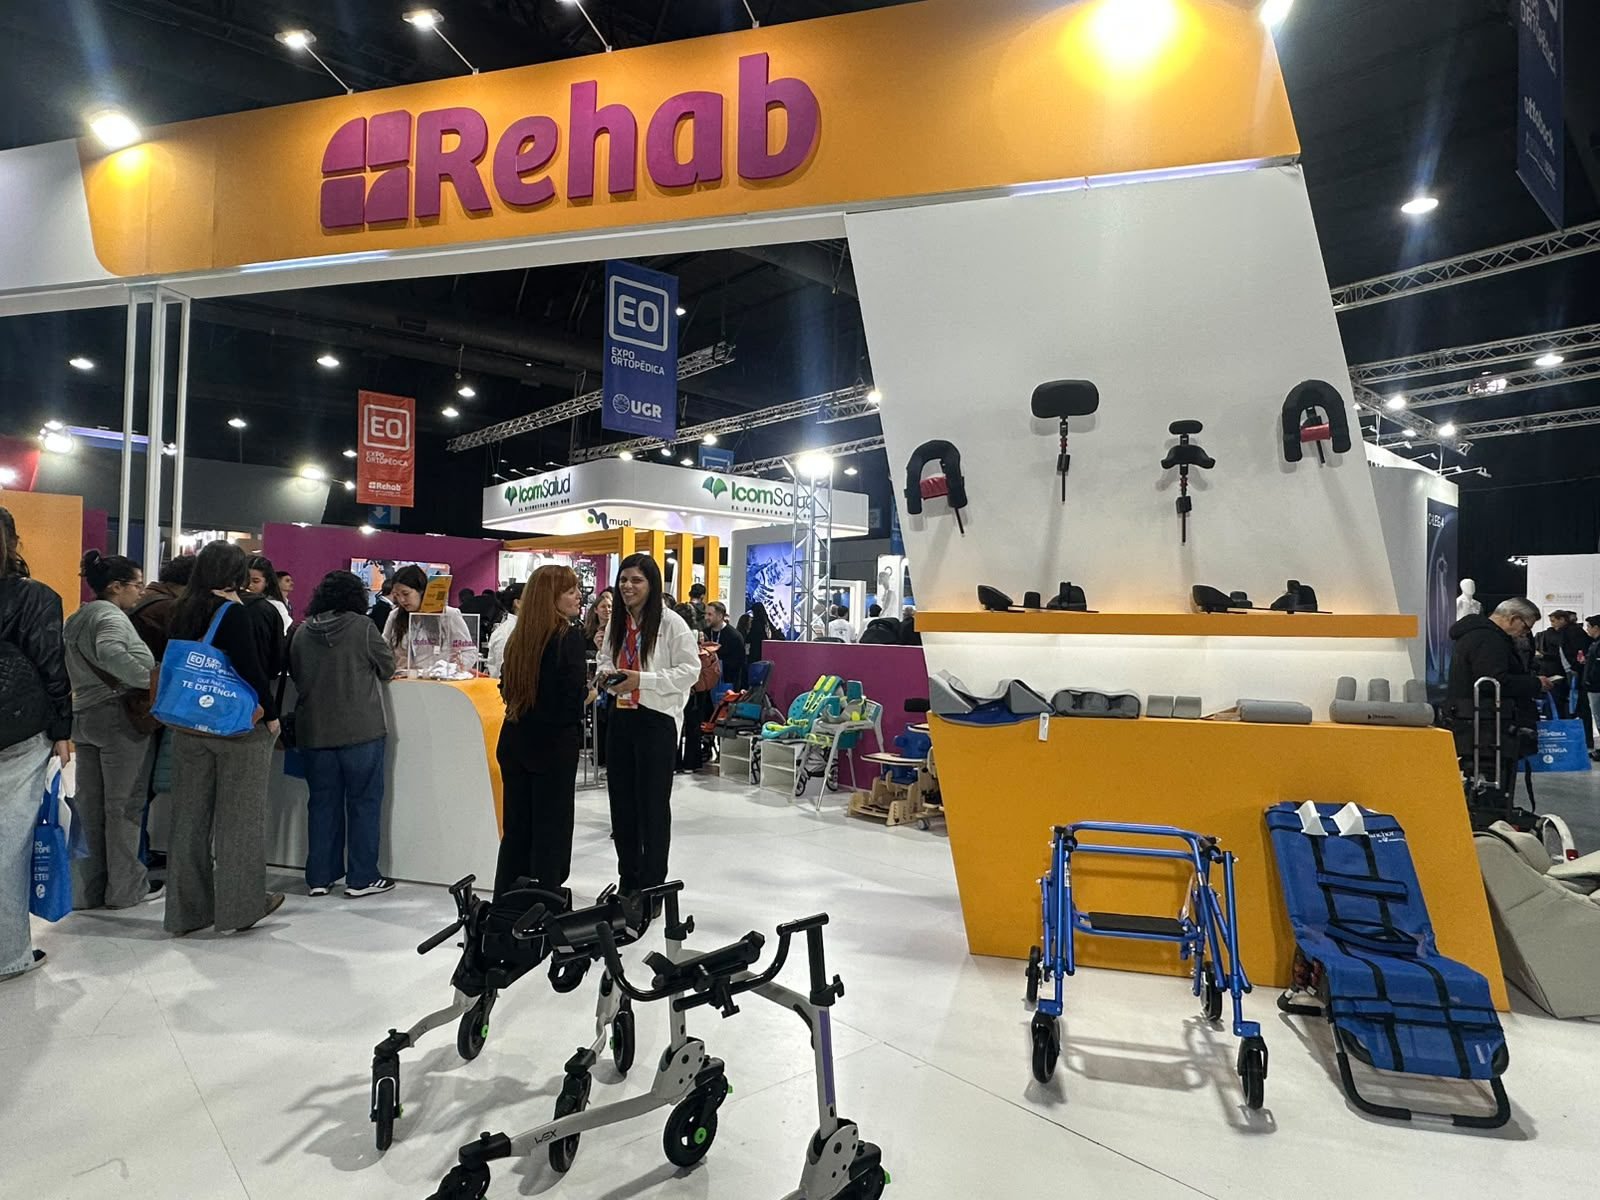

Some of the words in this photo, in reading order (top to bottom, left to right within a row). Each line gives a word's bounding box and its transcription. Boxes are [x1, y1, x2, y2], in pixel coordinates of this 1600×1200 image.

[415, 52, 818, 218] Rehab
[617, 294, 660, 332] EO
[611, 346, 635, 359] EXPO
[611, 355, 665, 376] ORTOPÉDICA
[630, 400, 662, 418] UGR
[370, 415, 403, 440] EO
[376, 482, 402, 492] Rehab
[518, 472, 571, 503] IcomSalud
[731, 481, 814, 510] IcomSau
[190, 654, 203, 664] EO
[182, 680, 193, 689] TE
[194, 683, 238, 699] DETENGA
